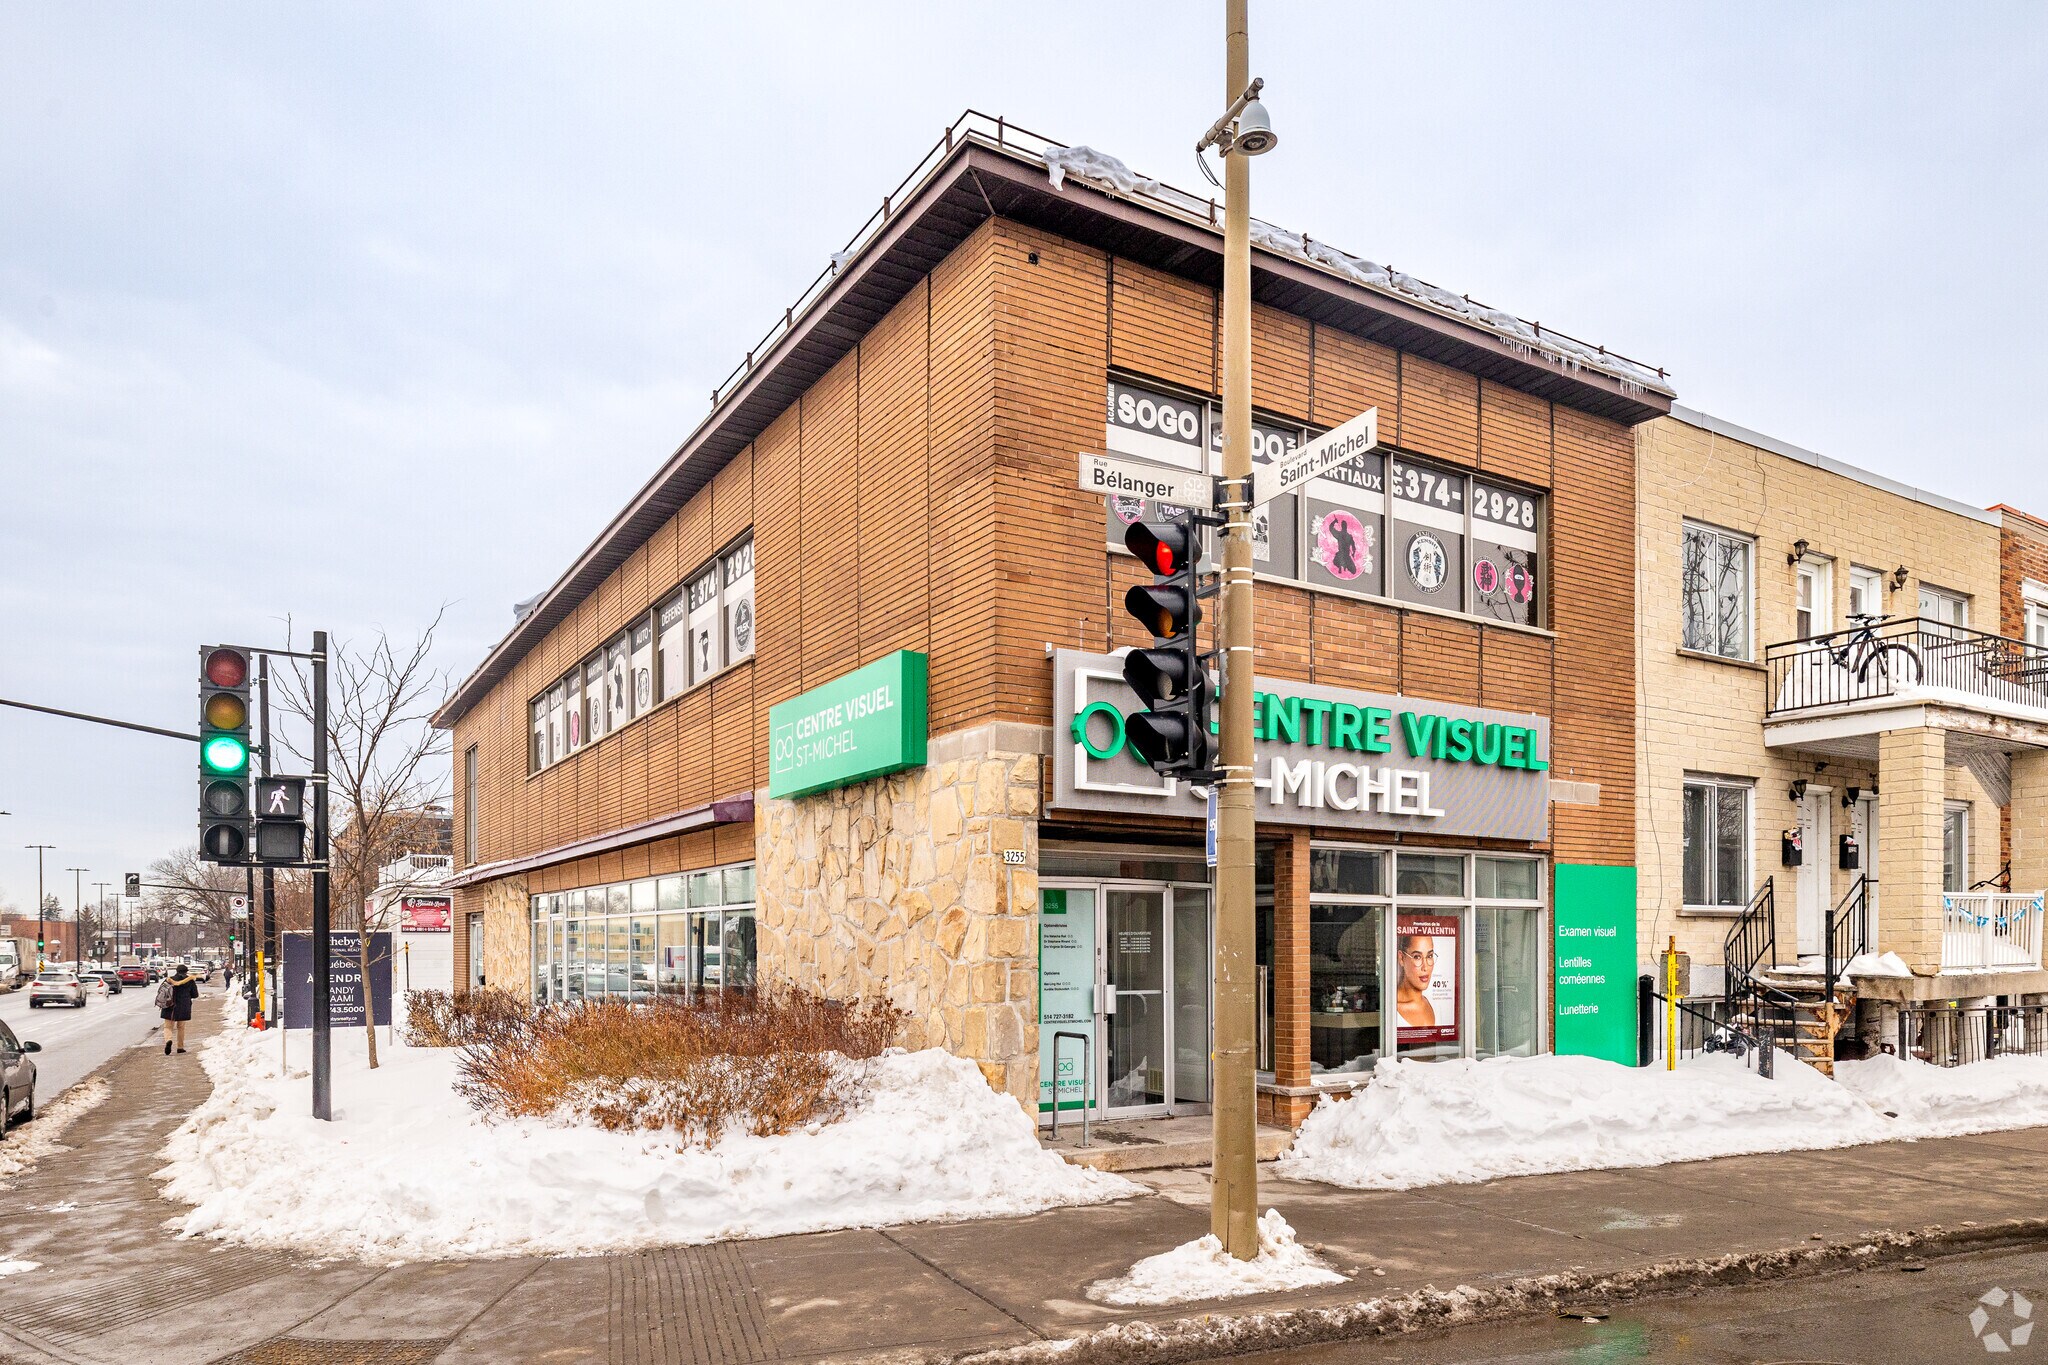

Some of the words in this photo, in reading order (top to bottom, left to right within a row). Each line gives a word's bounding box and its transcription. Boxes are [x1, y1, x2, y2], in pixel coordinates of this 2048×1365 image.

[1117, 393, 1199, 440] SOGO
[1093, 458, 1108, 468] Rue
[1279, 448, 1308, 469] Boulevard
[1280, 426, 1369, 487] Saint-Michel
[1093, 468, 1174, 498] Bélanger
[1324, 466, 1382, 490] RTIAUX
[1474, 488, 1534, 528] 2928
[796, 703, 842, 740] CENTRE
[845, 685, 893, 722] VISUEL
[796, 729, 858, 768] ST-MICHEL
[1399, 711, 1548, 771] VISUEL
[1005, 851, 1025, 863] 3255
[1397, 926, 1456, 935] SAINT-VALENTIN
[1559, 925, 1592, 937] Examen
[1593, 925, 1617, 937] visuel
[1559, 956, 1592, 968] Lentilles
[1432, 980, 1441, 988] 40
[1559, 1002, 1599, 1016] Lunetterie
